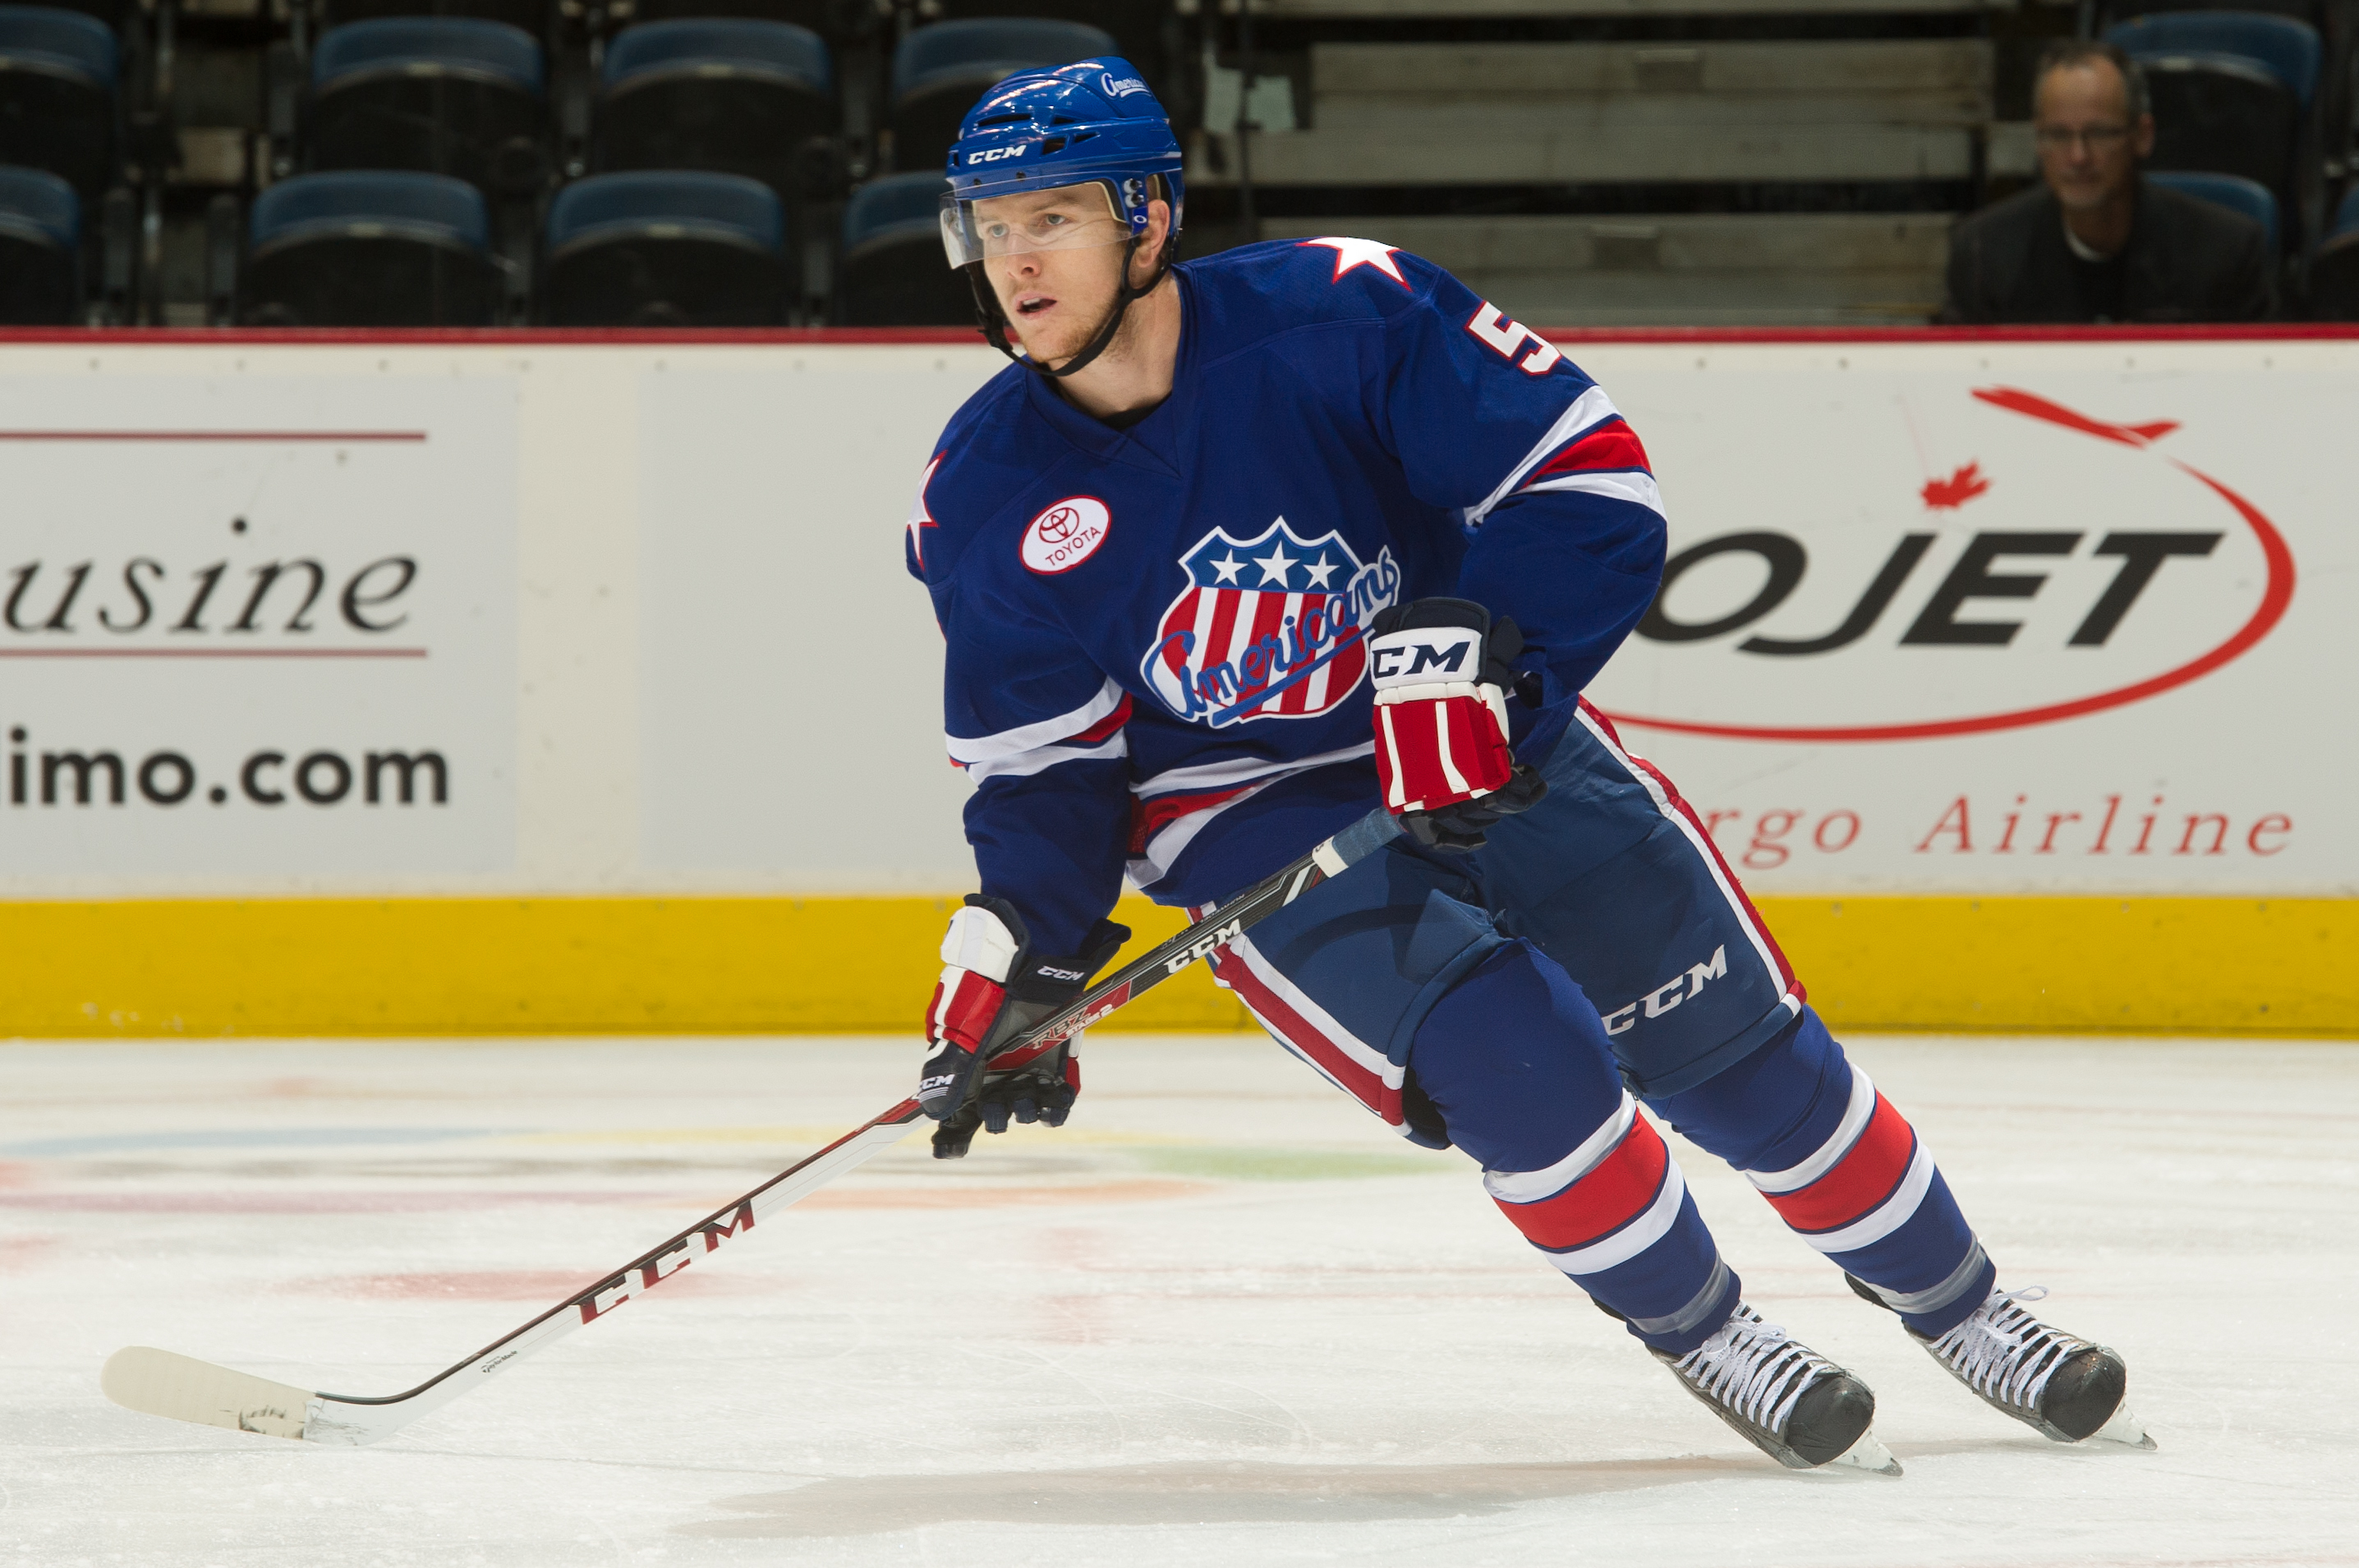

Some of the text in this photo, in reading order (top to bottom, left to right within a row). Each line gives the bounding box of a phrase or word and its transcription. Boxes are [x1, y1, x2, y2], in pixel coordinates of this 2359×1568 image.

[968, 145, 1026, 165] CCM
[1465, 300, 1561, 375] 5
[2, 515, 418, 634] usine
[1045, 525, 1101, 568] TOYOTA
[1633, 531, 2227, 657] OJET
[1143, 550, 1399, 720] Americans
[10, 725, 449, 807] imo.com
[1915, 794, 2292, 856] Airline
[1037, 965, 1085, 981] CCM
[1163, 918, 1241, 974] CCM
[1099, 1004, 1115, 1019] 2
[1601, 944, 1727, 1037] CCM
[572, 1199, 755, 1325] CCM
